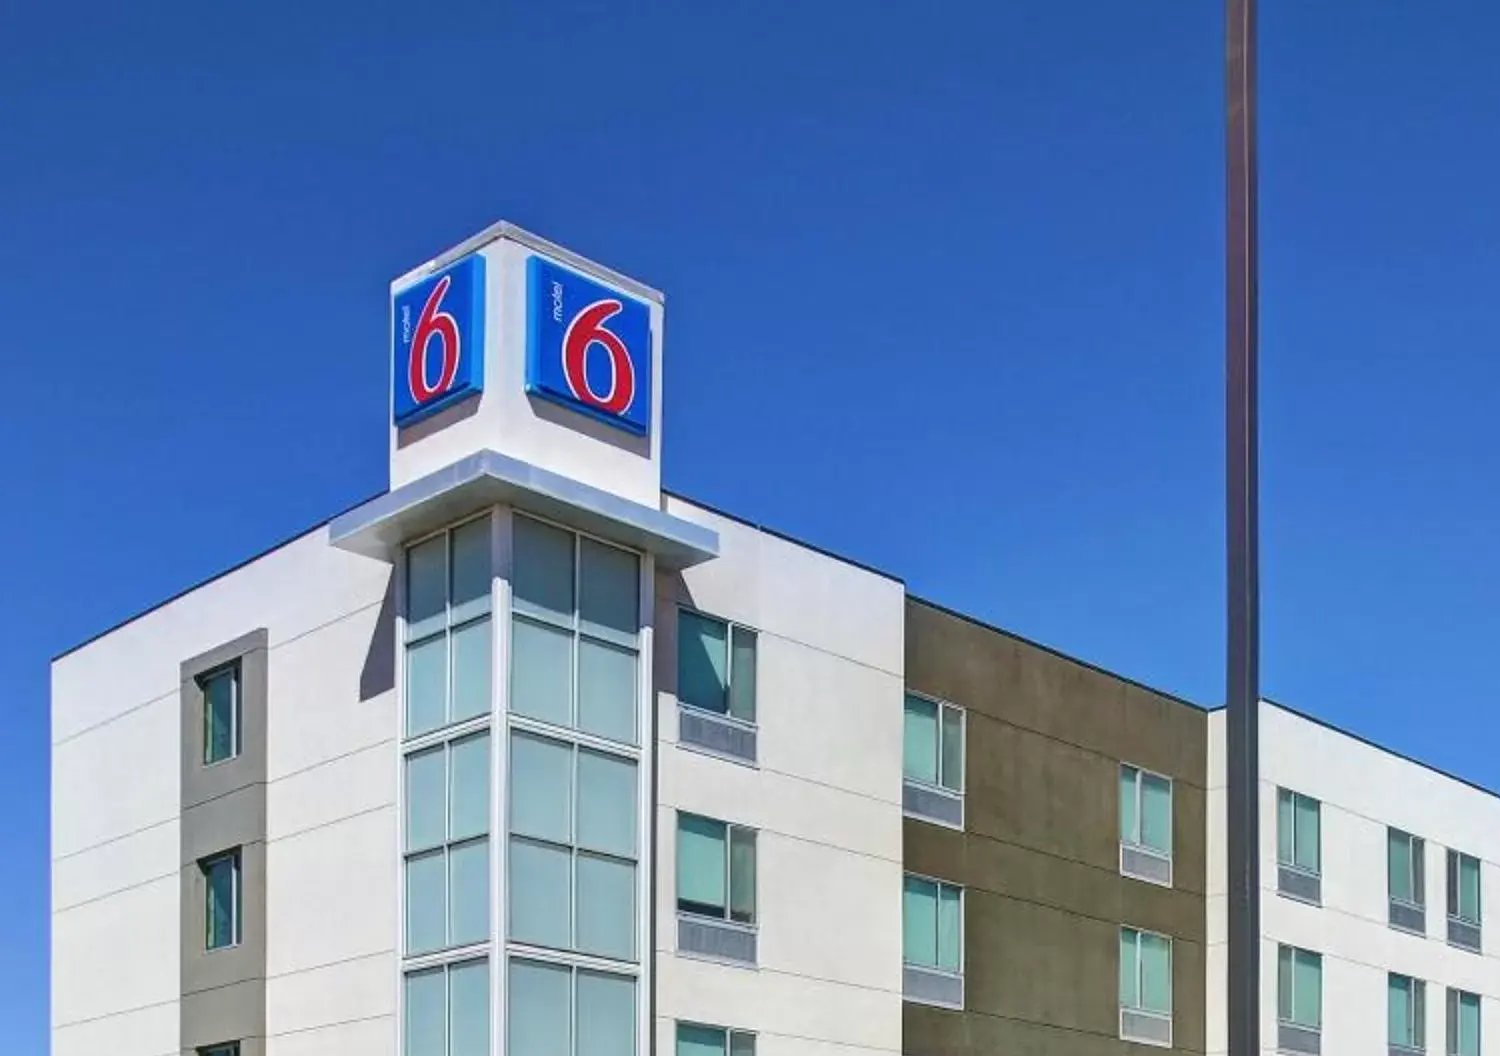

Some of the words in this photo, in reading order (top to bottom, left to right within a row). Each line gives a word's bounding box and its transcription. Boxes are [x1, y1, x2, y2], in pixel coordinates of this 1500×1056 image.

[408, 275, 461, 406] 6
[551, 281, 564, 323] motel
[561, 299, 636, 416] 6
